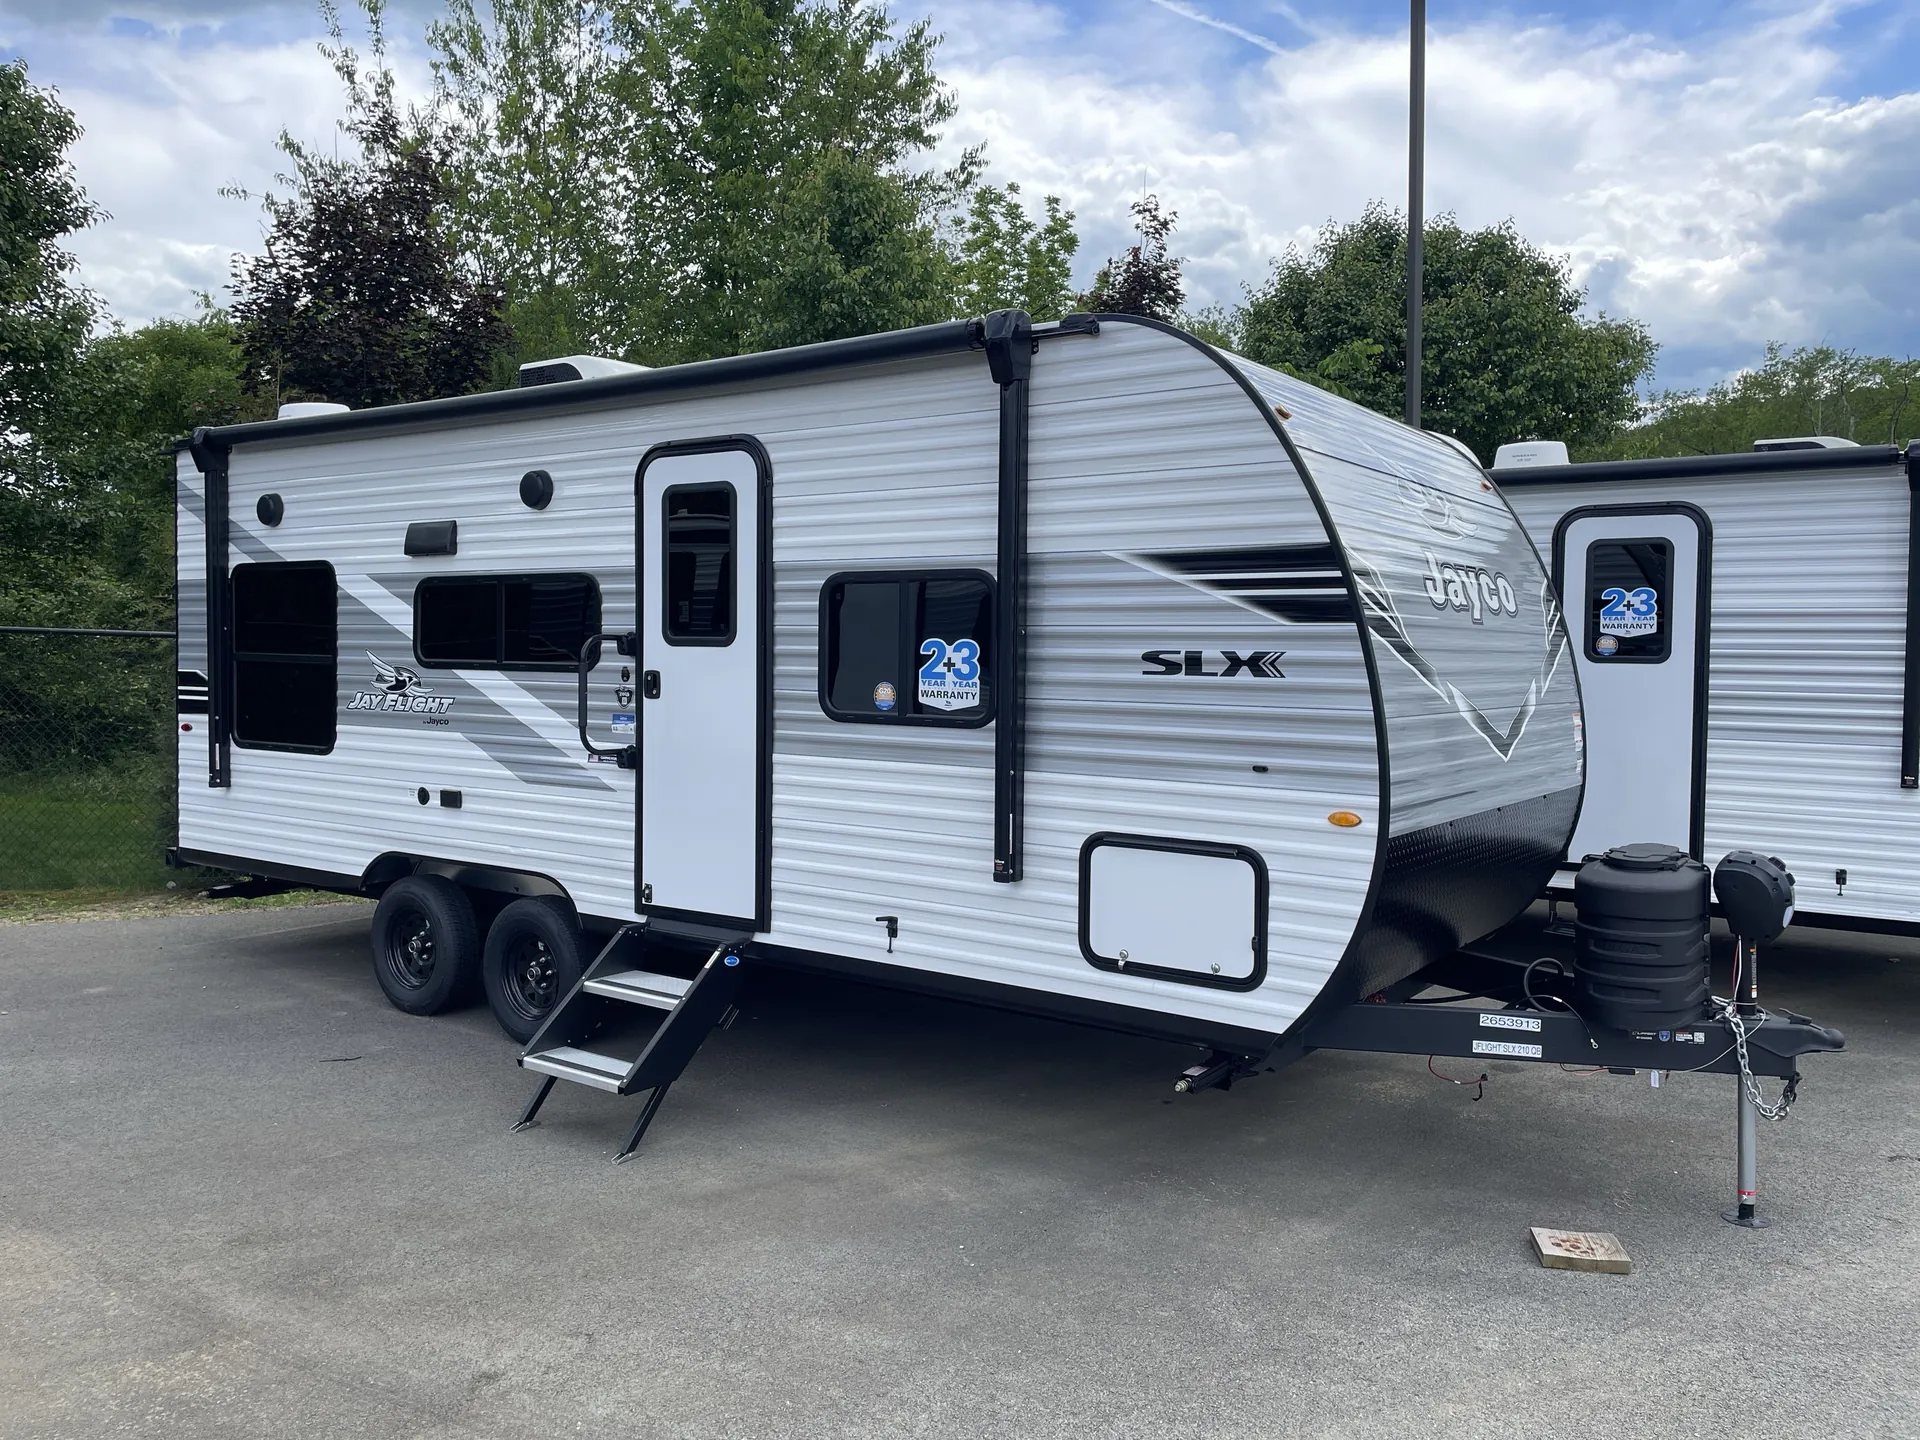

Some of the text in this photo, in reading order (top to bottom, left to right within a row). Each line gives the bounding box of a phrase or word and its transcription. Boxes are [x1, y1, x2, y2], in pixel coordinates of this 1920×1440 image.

[1421, 548, 1518, 625] Jayco
[1141, 650, 1286, 679] SLX
[920, 690, 977, 700] WARRANTY
[347, 691, 456, 714] JAY FLIGHT
[427, 716, 449, 727] Jayco
[1481, 1015, 1540, 1029] 2653913
[1473, 1042, 1502, 1053] JFLIGHT
[1502, 1044, 1517, 1054] SLX
[1517, 1045, 1530, 1055] 210
